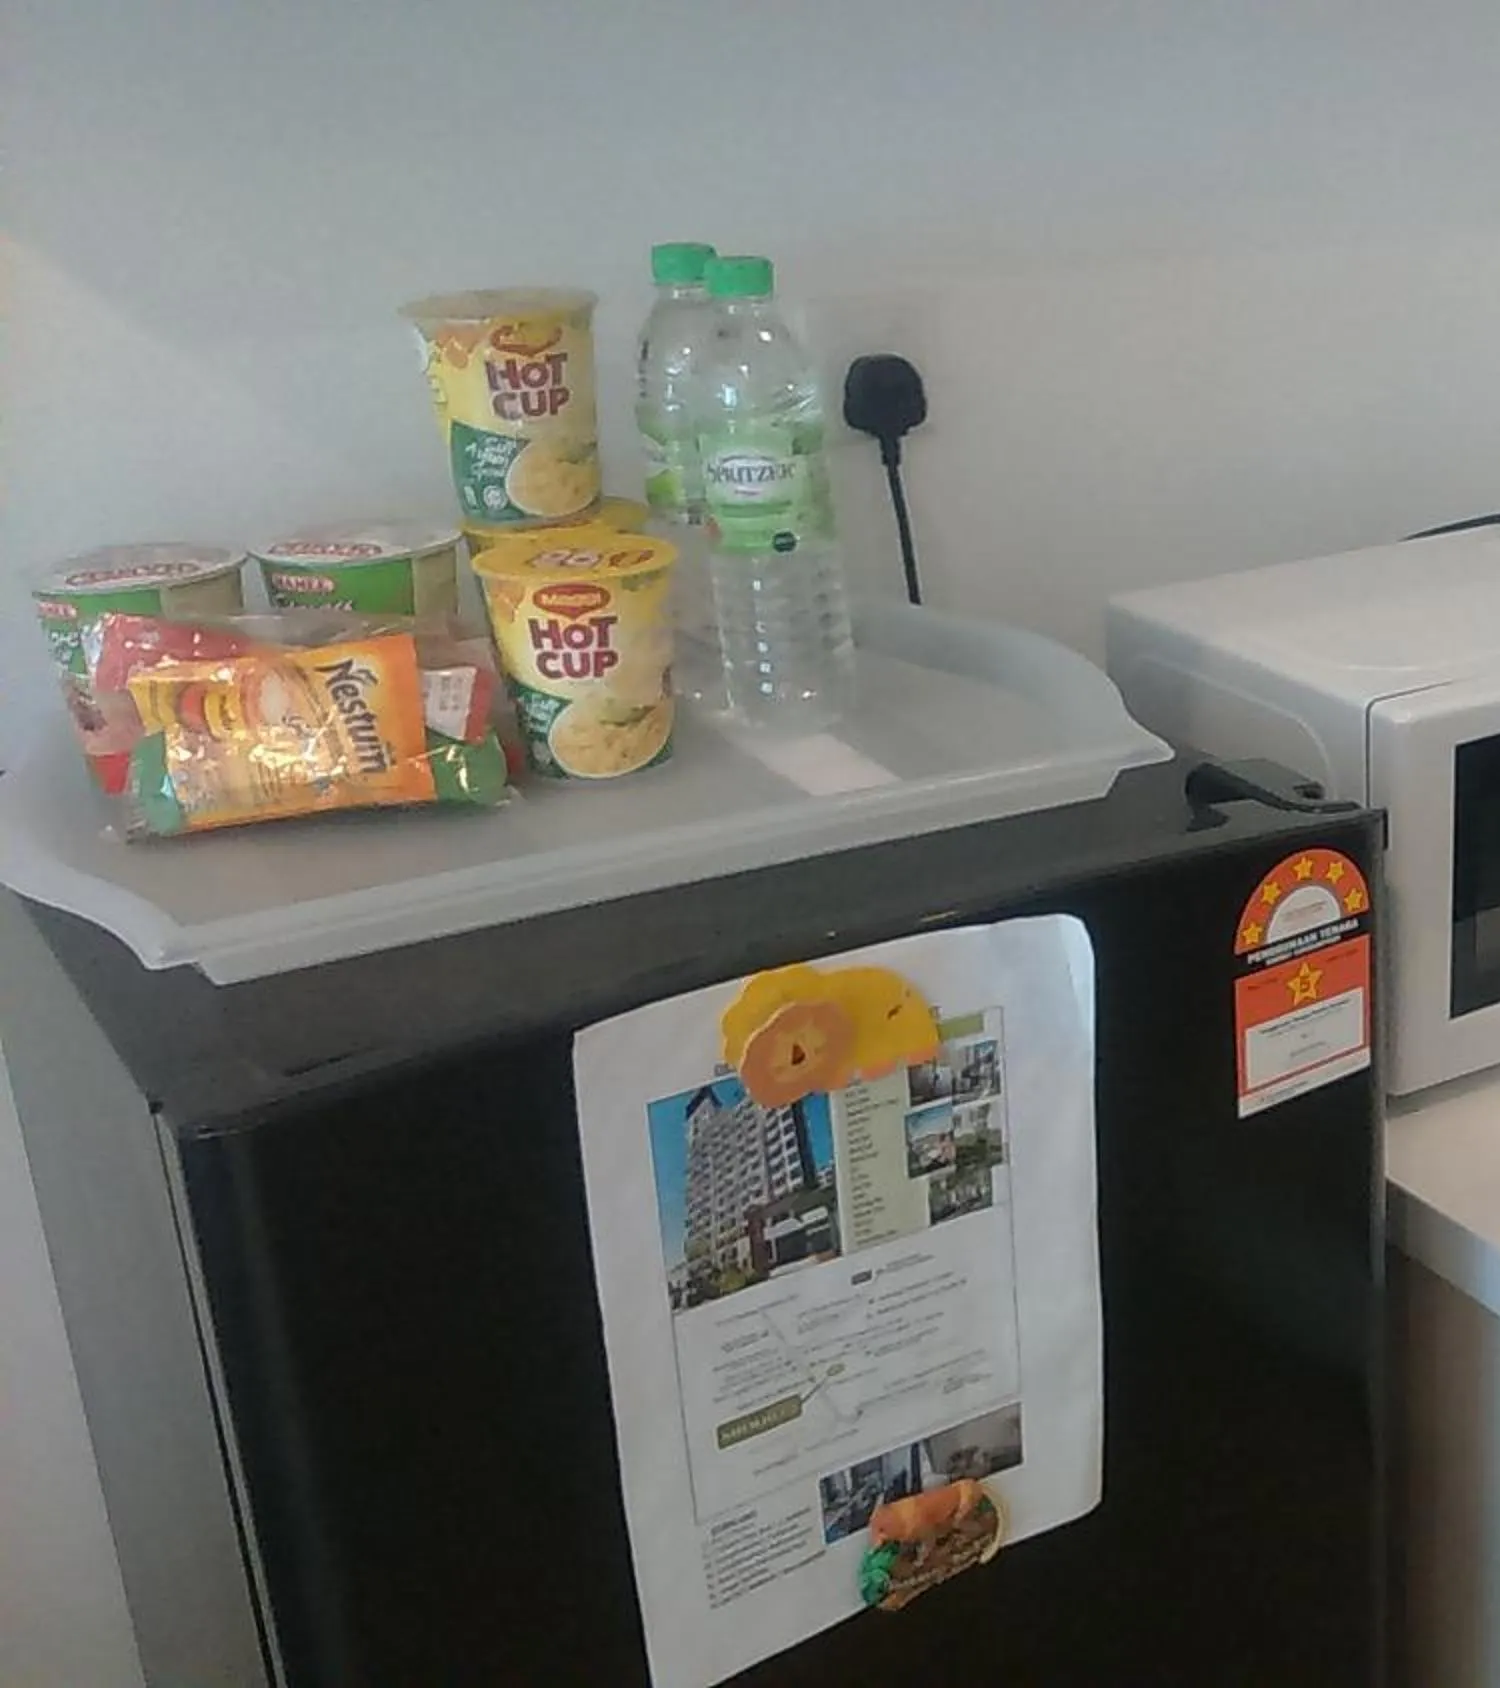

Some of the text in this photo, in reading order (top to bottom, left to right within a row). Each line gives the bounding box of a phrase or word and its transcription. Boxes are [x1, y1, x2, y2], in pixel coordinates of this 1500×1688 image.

[485, 353, 569, 391] HOT
[492, 387, 571, 421] CUP
[527, 616, 619, 650] HOT
[536, 650, 619, 679] CUP
[314, 659, 387, 773] Nestum
